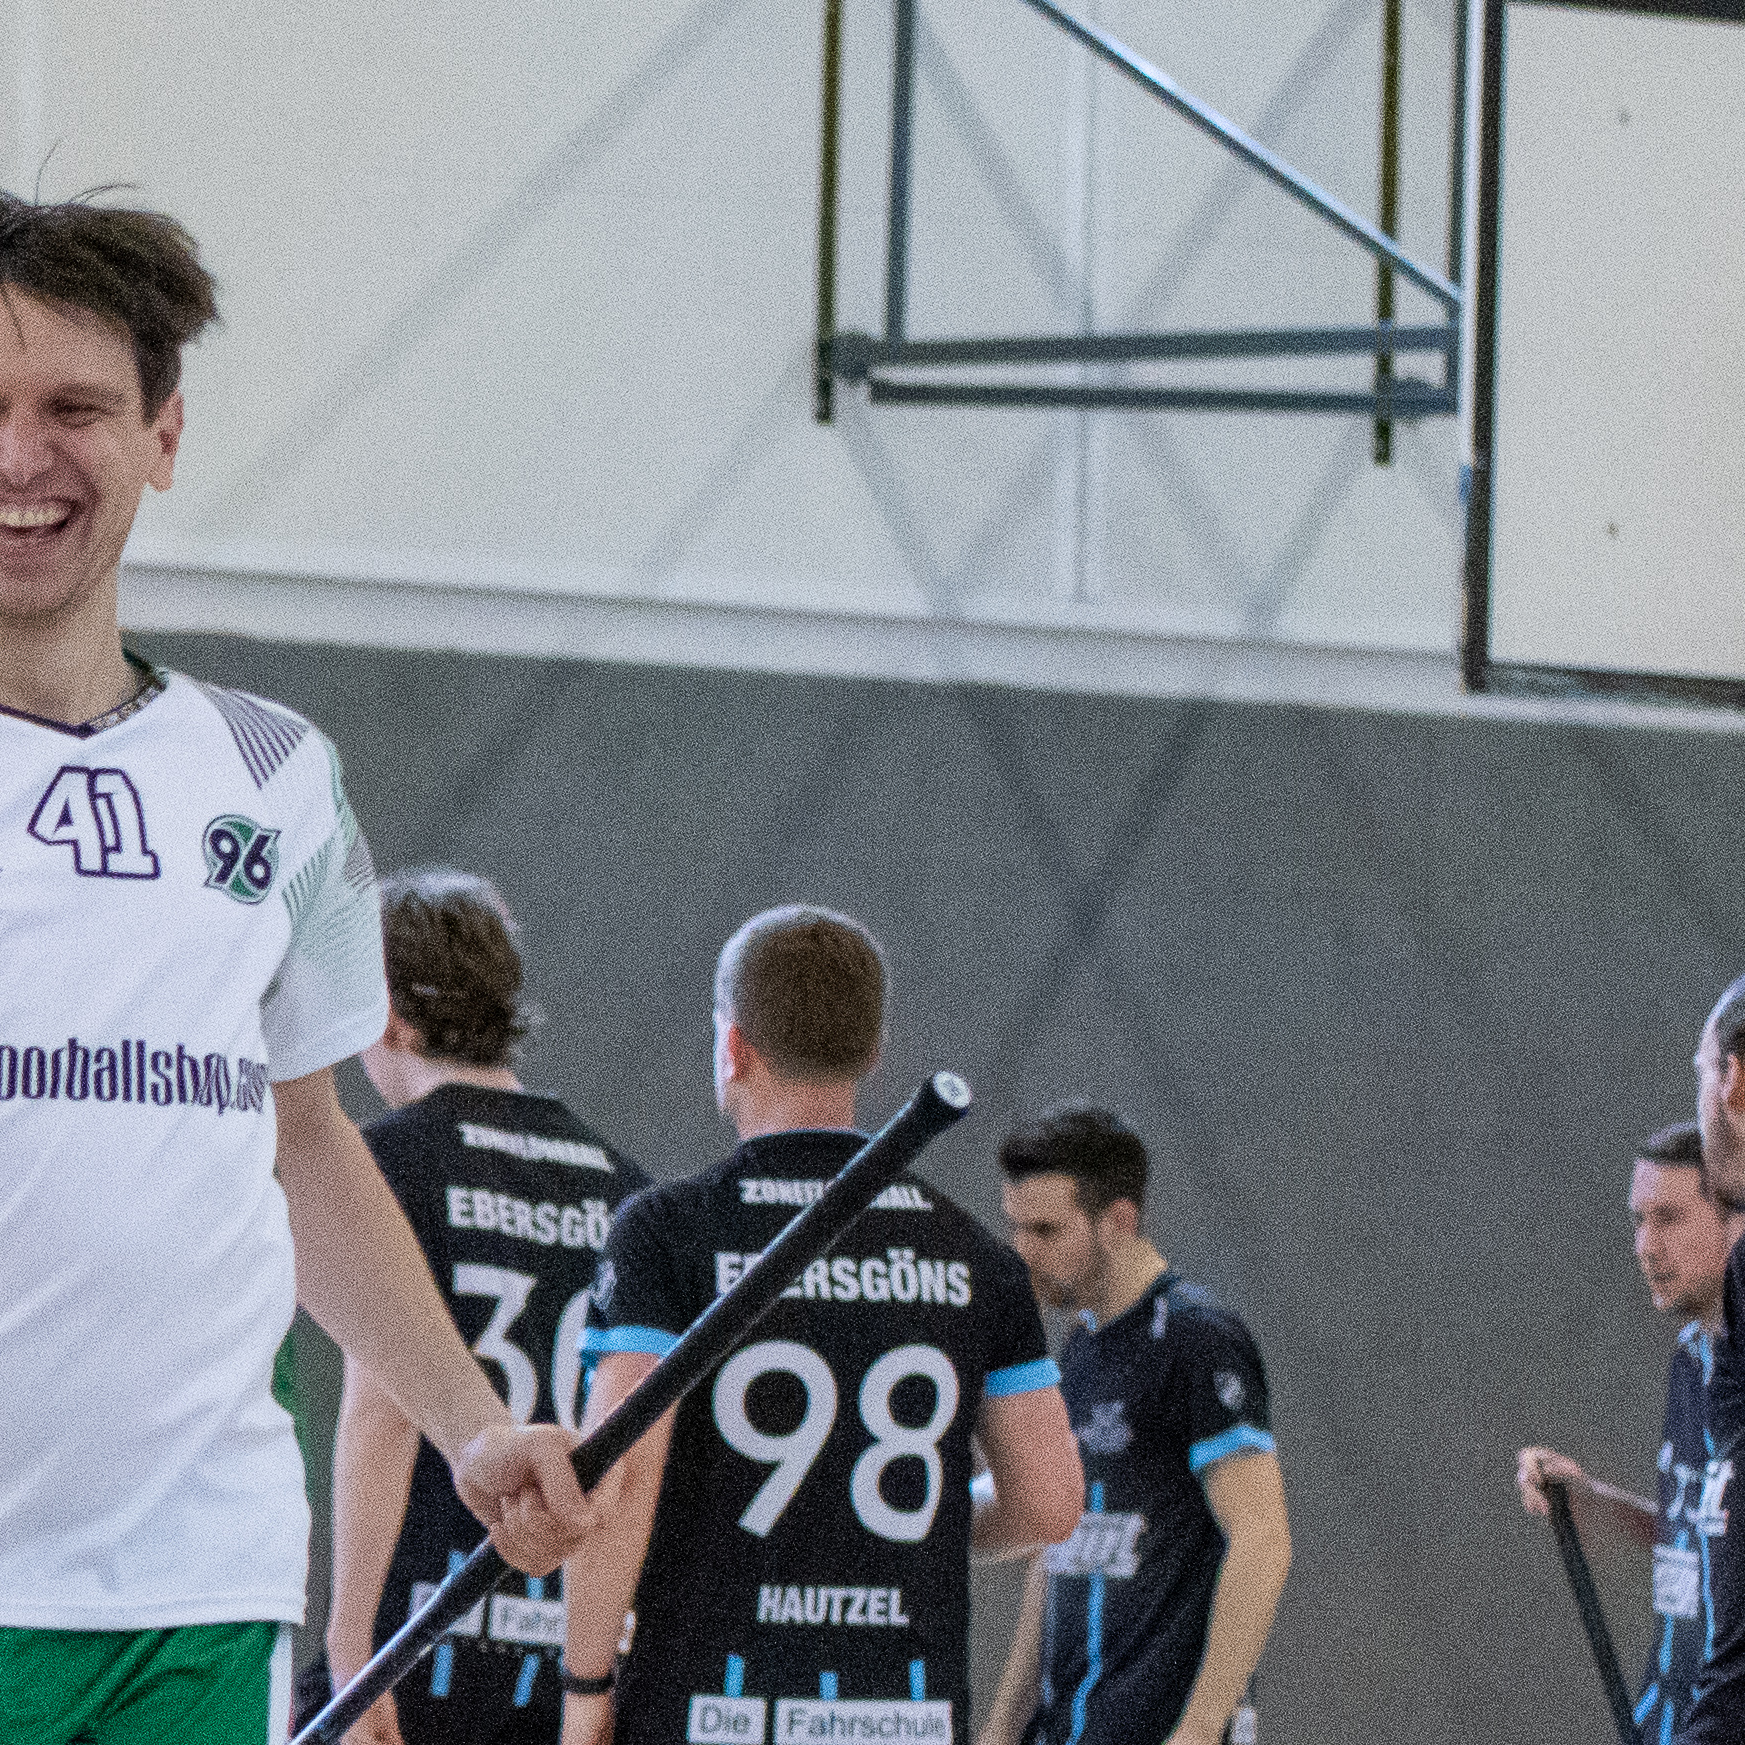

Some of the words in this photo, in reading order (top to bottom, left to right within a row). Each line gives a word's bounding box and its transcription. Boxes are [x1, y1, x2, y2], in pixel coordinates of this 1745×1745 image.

[28, 765, 160, 880] 41
[207, 827, 276, 892] 96
[447, 1185, 611, 1252] EBERSGÖ
[712, 1339, 960, 1544] 98
[757, 1585, 910, 1627] HAUTZEL
[699, 1704, 752, 1735] Die
[787, 1708, 946, 1739] Fahrschule
